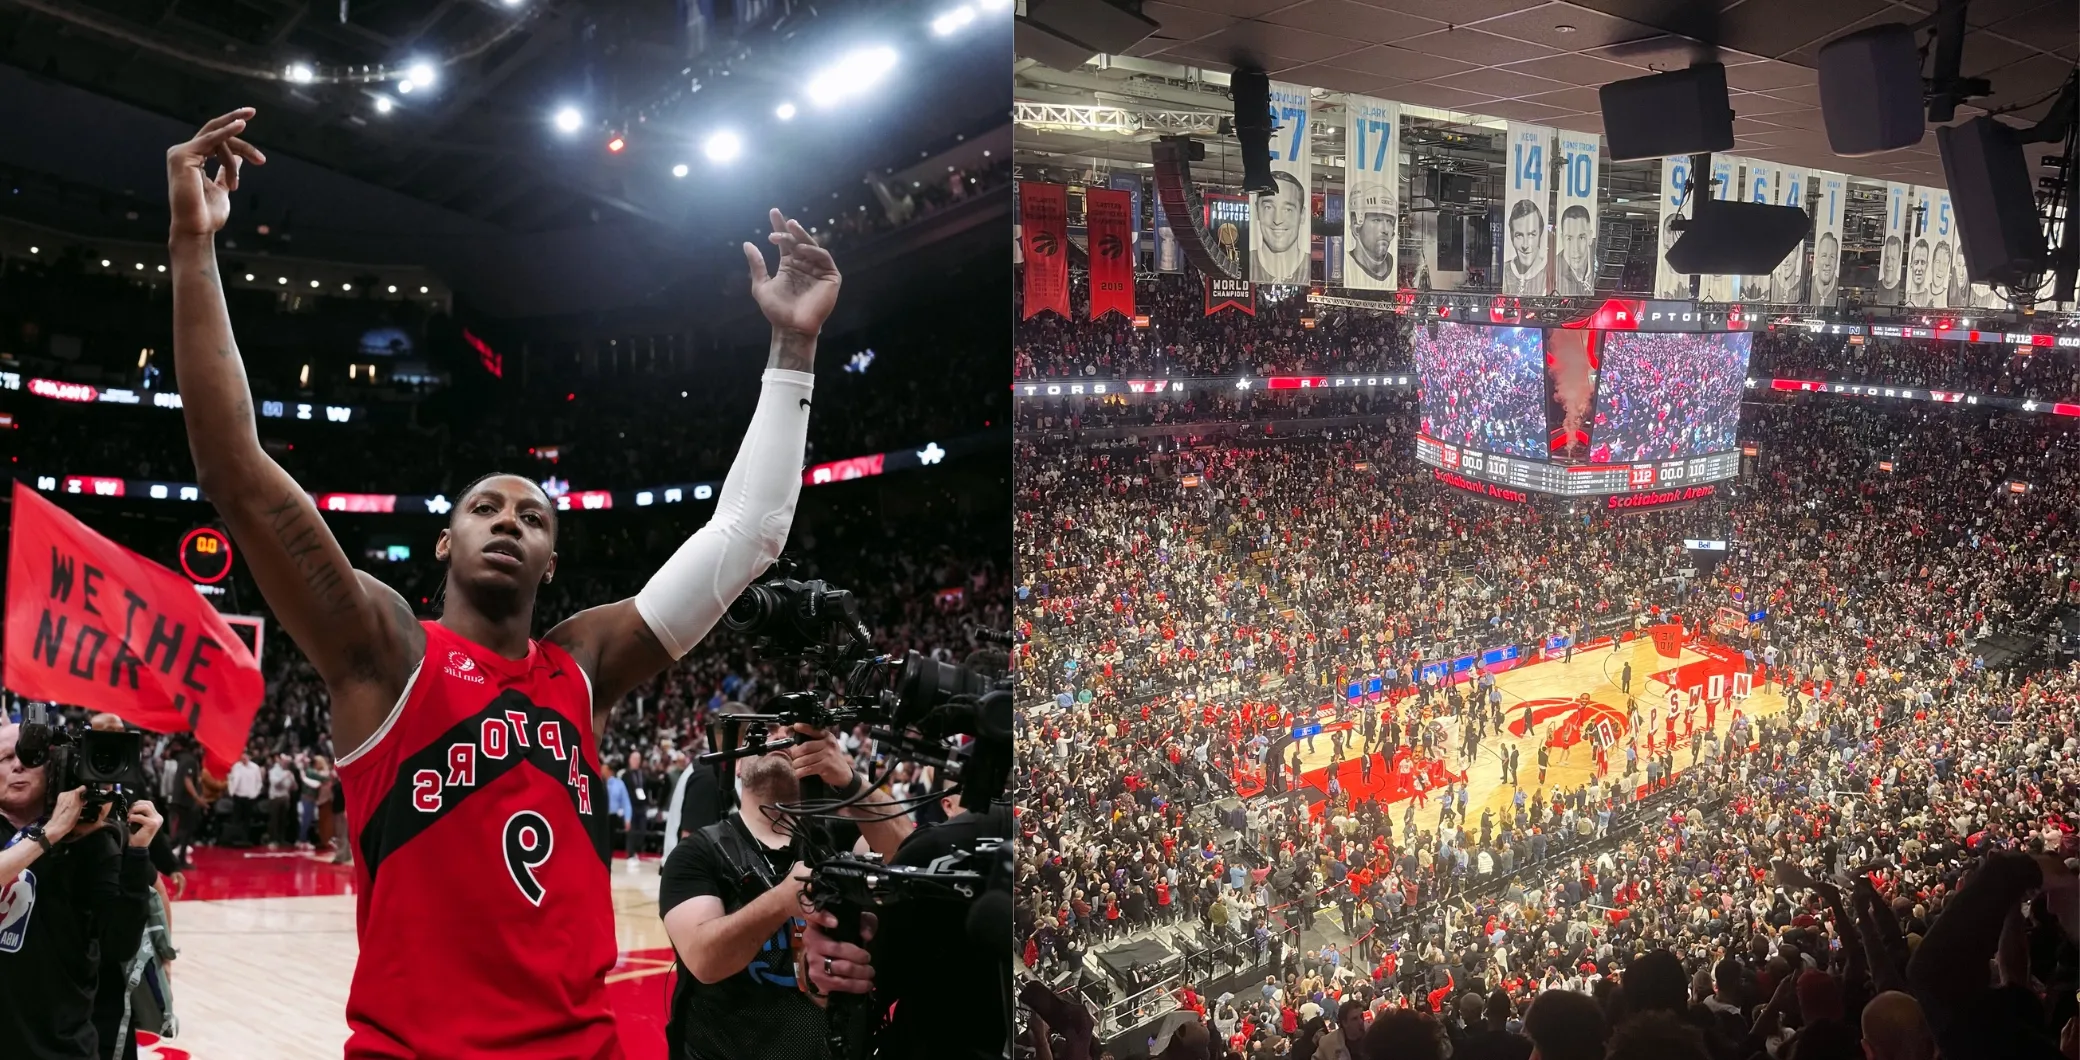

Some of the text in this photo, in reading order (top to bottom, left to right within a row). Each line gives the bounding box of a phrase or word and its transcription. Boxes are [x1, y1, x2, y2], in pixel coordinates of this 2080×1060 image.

[1356, 118, 1391, 172] 17
[1515, 143, 1543, 191] 14
[1567, 151, 1592, 198] 10
[1670, 165, 1687, 206] 9
[1715, 172, 1729, 200] 7
[1753, 177, 1767, 204] 6
[1939, 203, 1950, 236] 5
[1101, 282, 1124, 291] 2019
[1213, 279, 1249, 290] WORLD
[1213, 290, 1249, 298] CHAMPIONS
[1810, 324, 1861, 335] WIN
[2015, 334, 2032, 344] 112
[1130, 382, 1184, 393] WIN
[1302, 376, 1408, 388] RAPTORS
[1801, 383, 1977, 405] RAPTORS WIN
[1444, 449, 1457, 465] 112
[1462, 455, 1483, 471] 00.0
[1488, 461, 1506, 476] 110
[1632, 470, 1651, 482] 112
[1660, 466, 1684, 480] 00.0
[1689, 464, 1705, 477] 110
[1433, 467, 1487, 494] Scotiabank
[1488, 484, 1527, 503] Arena
[1608, 484, 1716, 509] Scotiabank Arena
[1698, 540, 1711, 549] Bell
[51, 545, 105, 616] WE
[123, 589, 223, 694] THE
